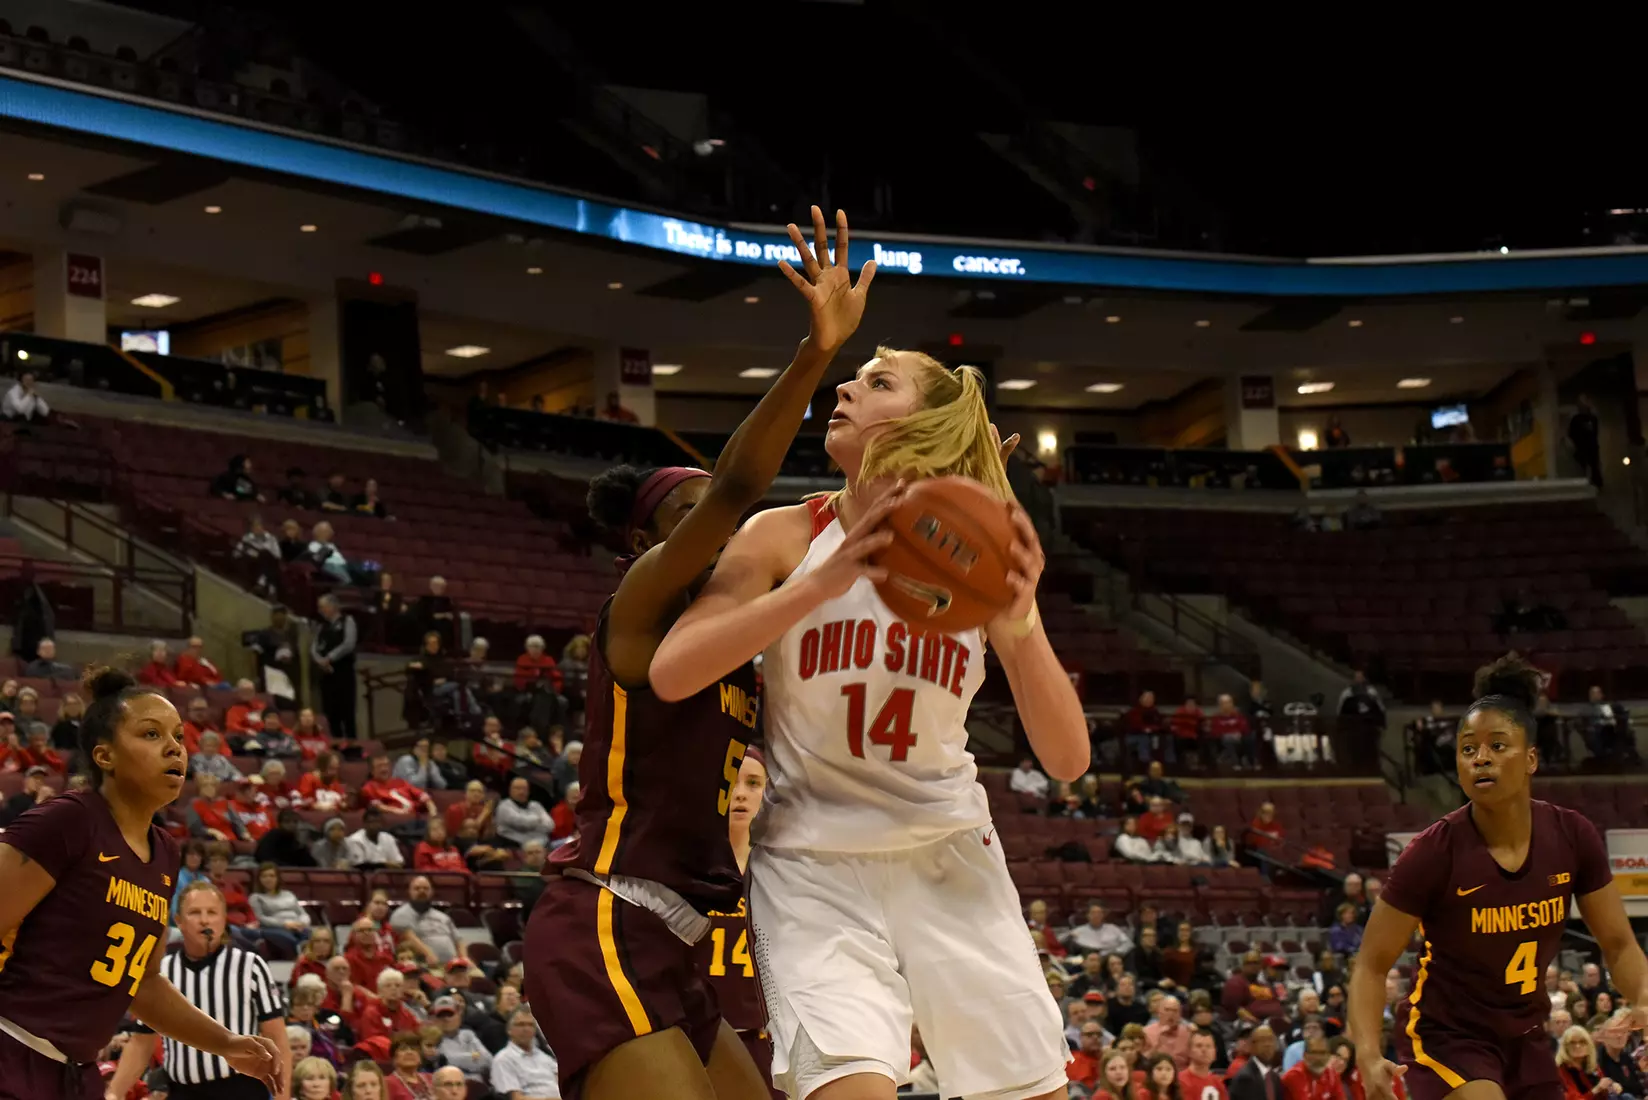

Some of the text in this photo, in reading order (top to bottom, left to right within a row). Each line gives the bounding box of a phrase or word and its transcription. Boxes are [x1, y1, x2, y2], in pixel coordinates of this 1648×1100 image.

[69, 265, 99, 285] 224
[662, 221, 714, 252] There
[715, 233, 733, 255] is
[735, 240, 762, 258] no
[873, 243, 923, 275] lung
[952, 255, 1026, 275] cancer.
[799, 619, 970, 700] OHIO STATE
[841, 682, 918, 762] 14
[717, 738, 746, 816] 5
[1471, 896, 1565, 934] MINNESOTA
[89, 921, 158, 997] 34
[709, 927, 755, 978] 14
[1505, 940, 1539, 996] 4
